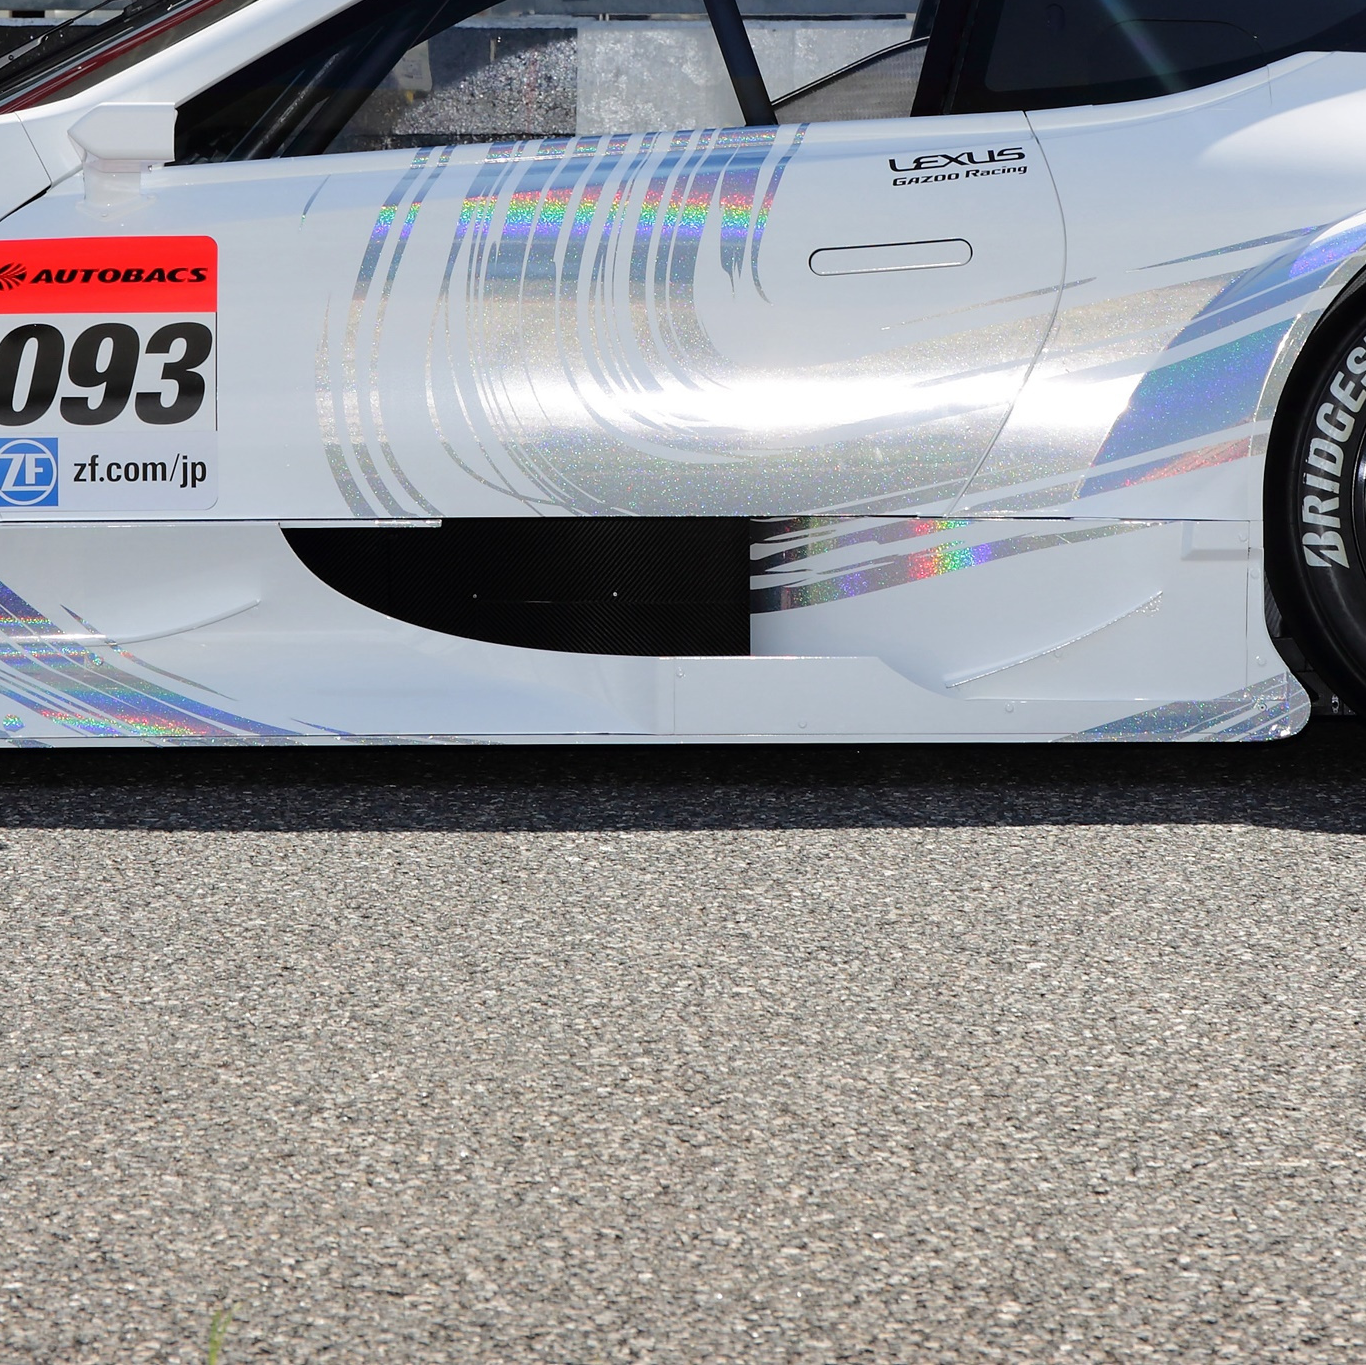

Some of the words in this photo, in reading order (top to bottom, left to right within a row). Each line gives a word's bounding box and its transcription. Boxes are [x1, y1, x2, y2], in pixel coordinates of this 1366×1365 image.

[888, 146, 1027, 173] LEXUS
[892, 172, 961, 187] GAZOO
[964, 163, 1029, 180] Racing
[29, 266, 209, 285] AUTOBACS
[73, 453, 208, 489] zf.com/jp
